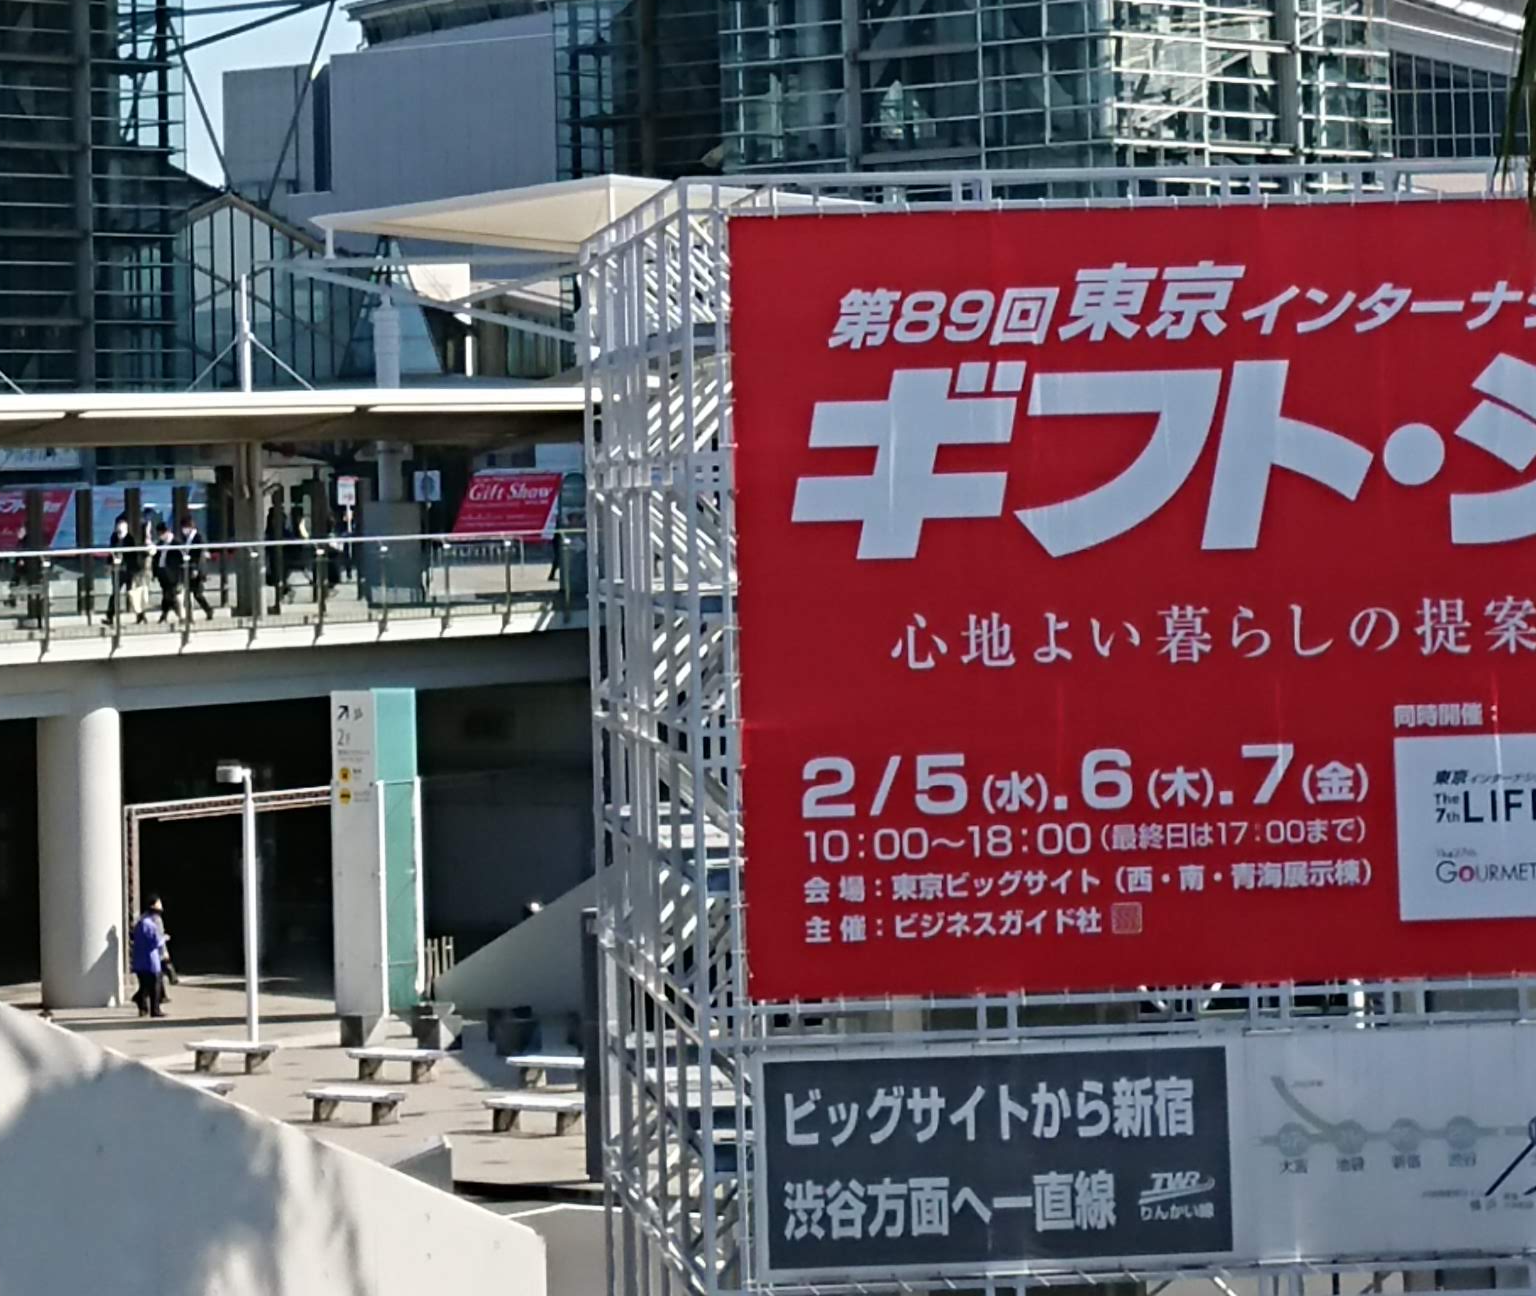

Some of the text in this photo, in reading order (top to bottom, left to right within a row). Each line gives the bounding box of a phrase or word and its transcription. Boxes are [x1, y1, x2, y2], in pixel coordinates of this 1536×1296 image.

[468, 482, 553, 501] Gift Show
[1434, 807, 1461, 824] 7th
[784, 1076, 1195, 1148] ビッグサイトから新宿
[784, 1168, 1117, 1240] 渋谷方面へ一直線
